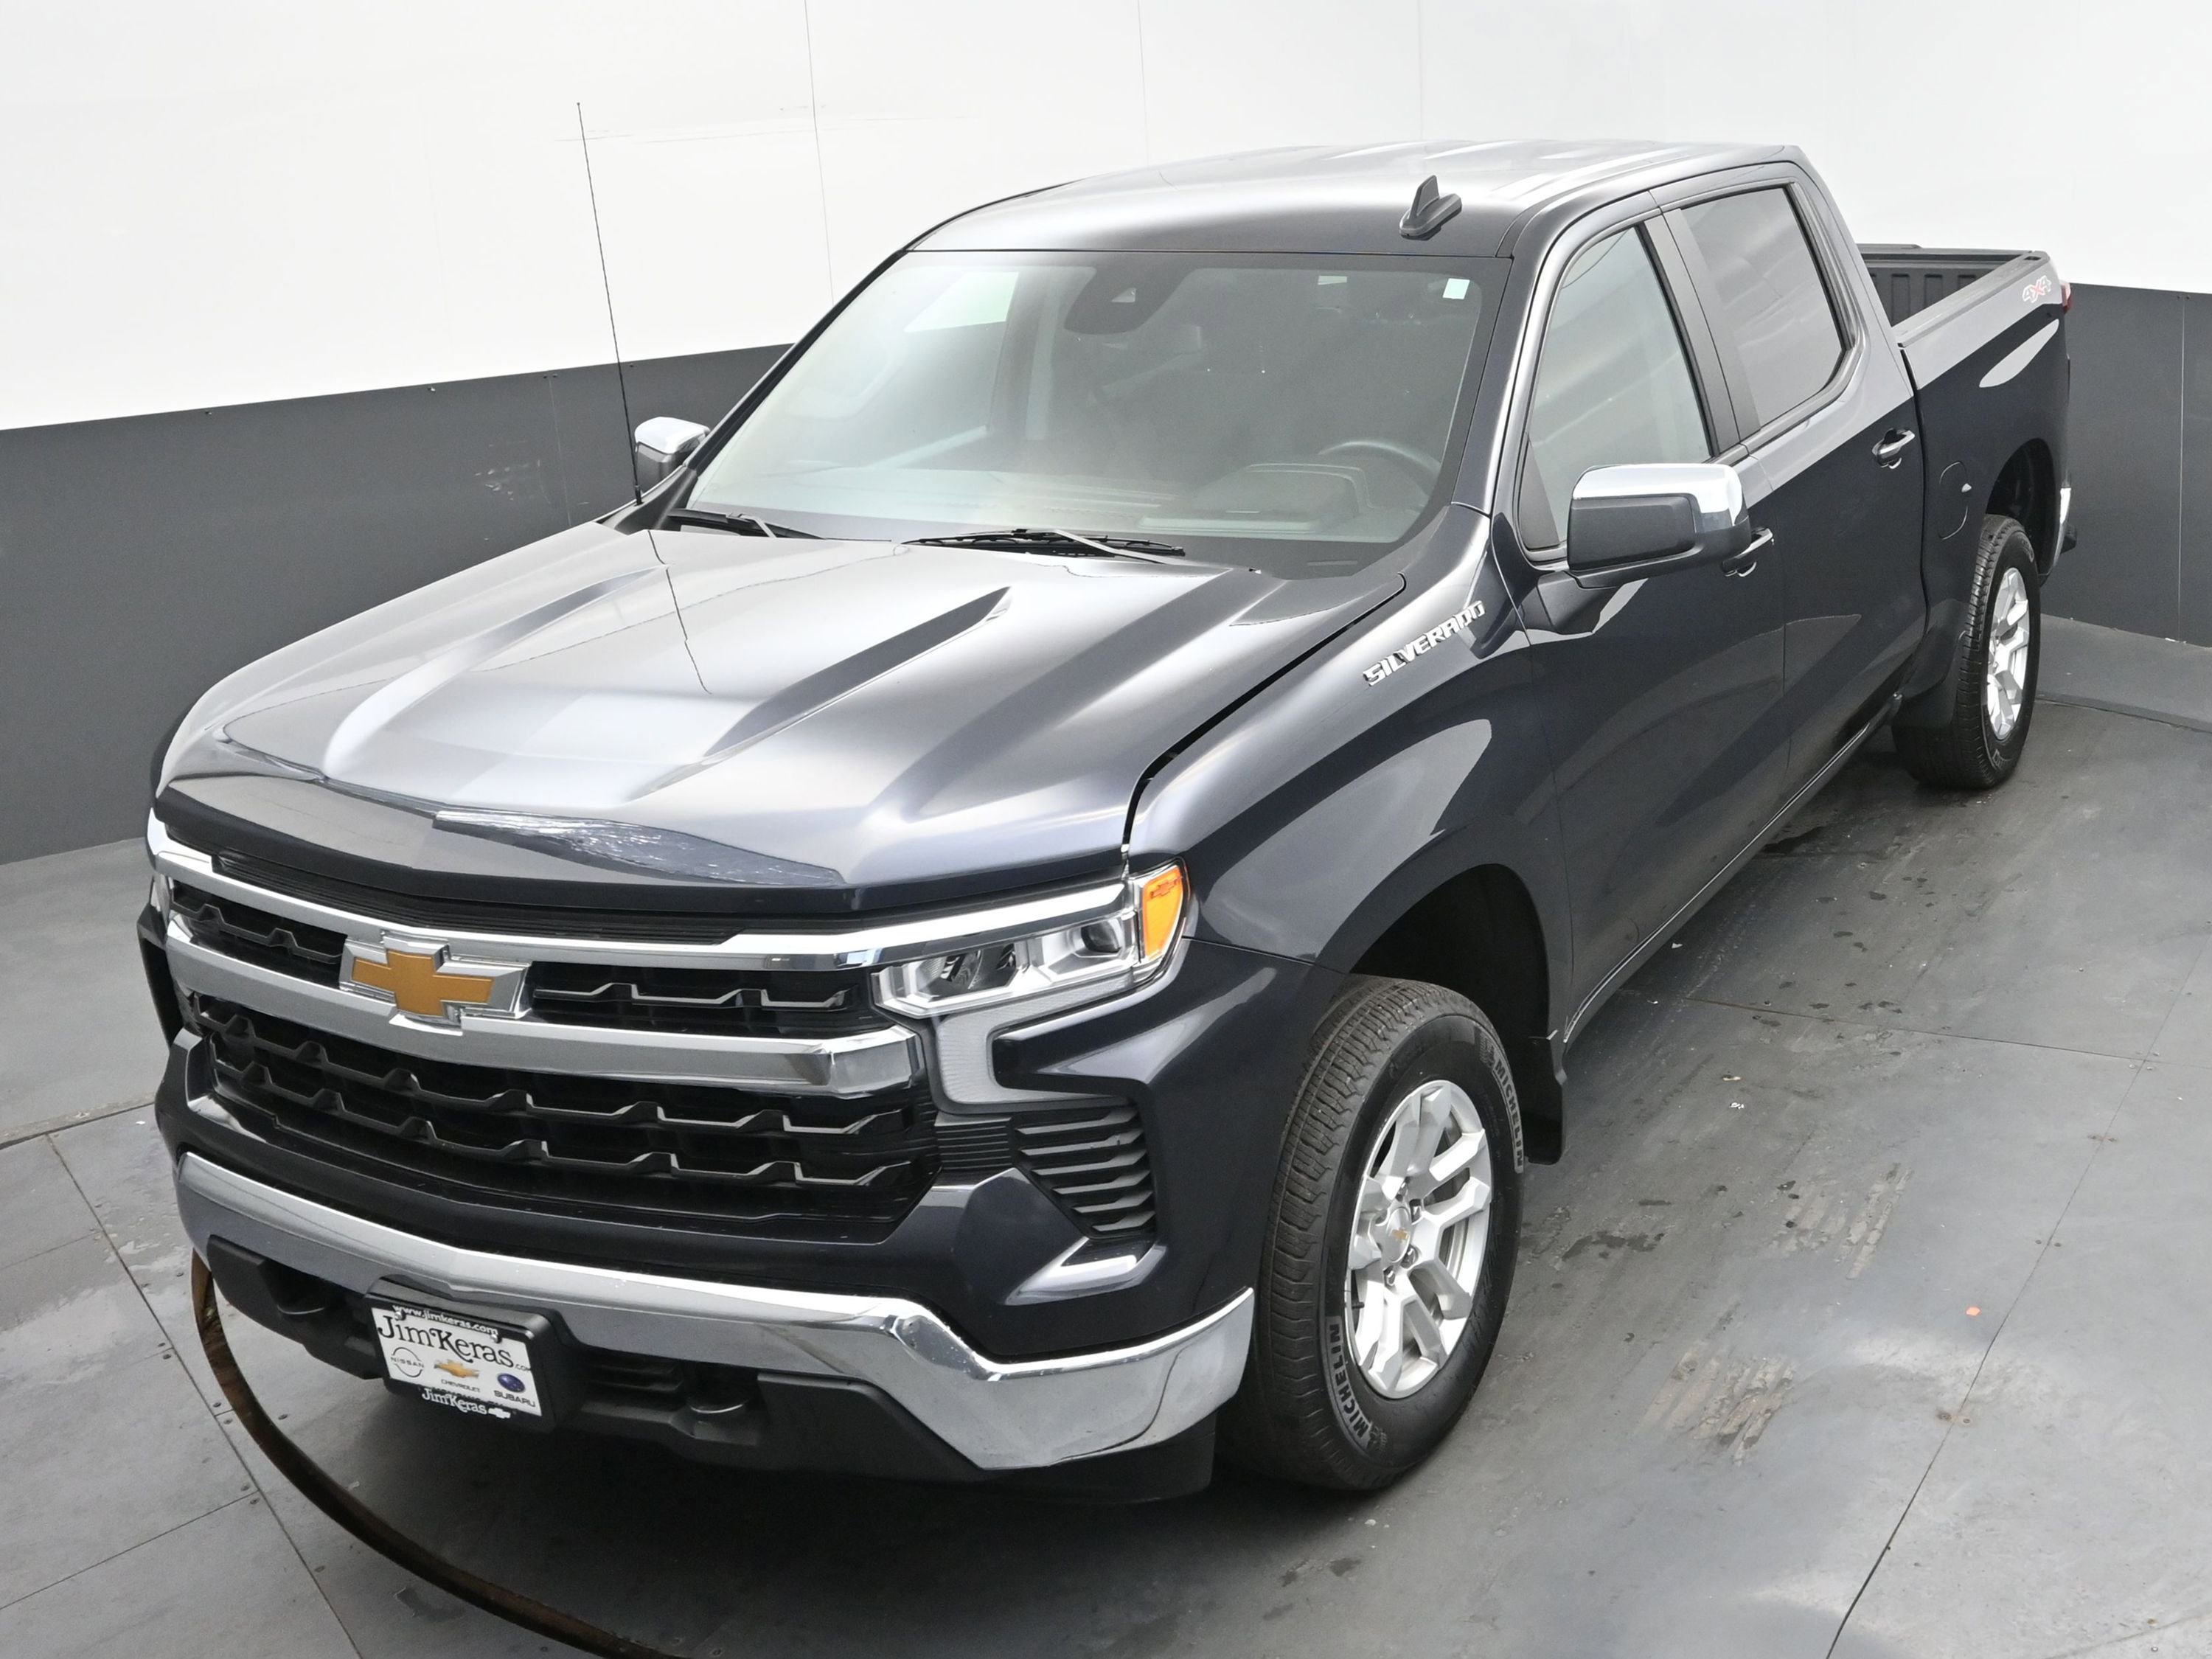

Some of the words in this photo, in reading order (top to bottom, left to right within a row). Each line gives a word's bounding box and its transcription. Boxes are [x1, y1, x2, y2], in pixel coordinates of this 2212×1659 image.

[1363, 600, 1486, 686] SILVERADO
[1495, 1059, 1523, 1166] MICHELIN
[392, 1304, 498, 1336] www.jimkeras.com
[390, 1356, 425, 1368] NISSAN
[441, 1379, 481, 1393] CHEVROLET
[1329, 1324, 1369, 1439] MICHELIN
[493, 1390, 536, 1408] SUBARU
